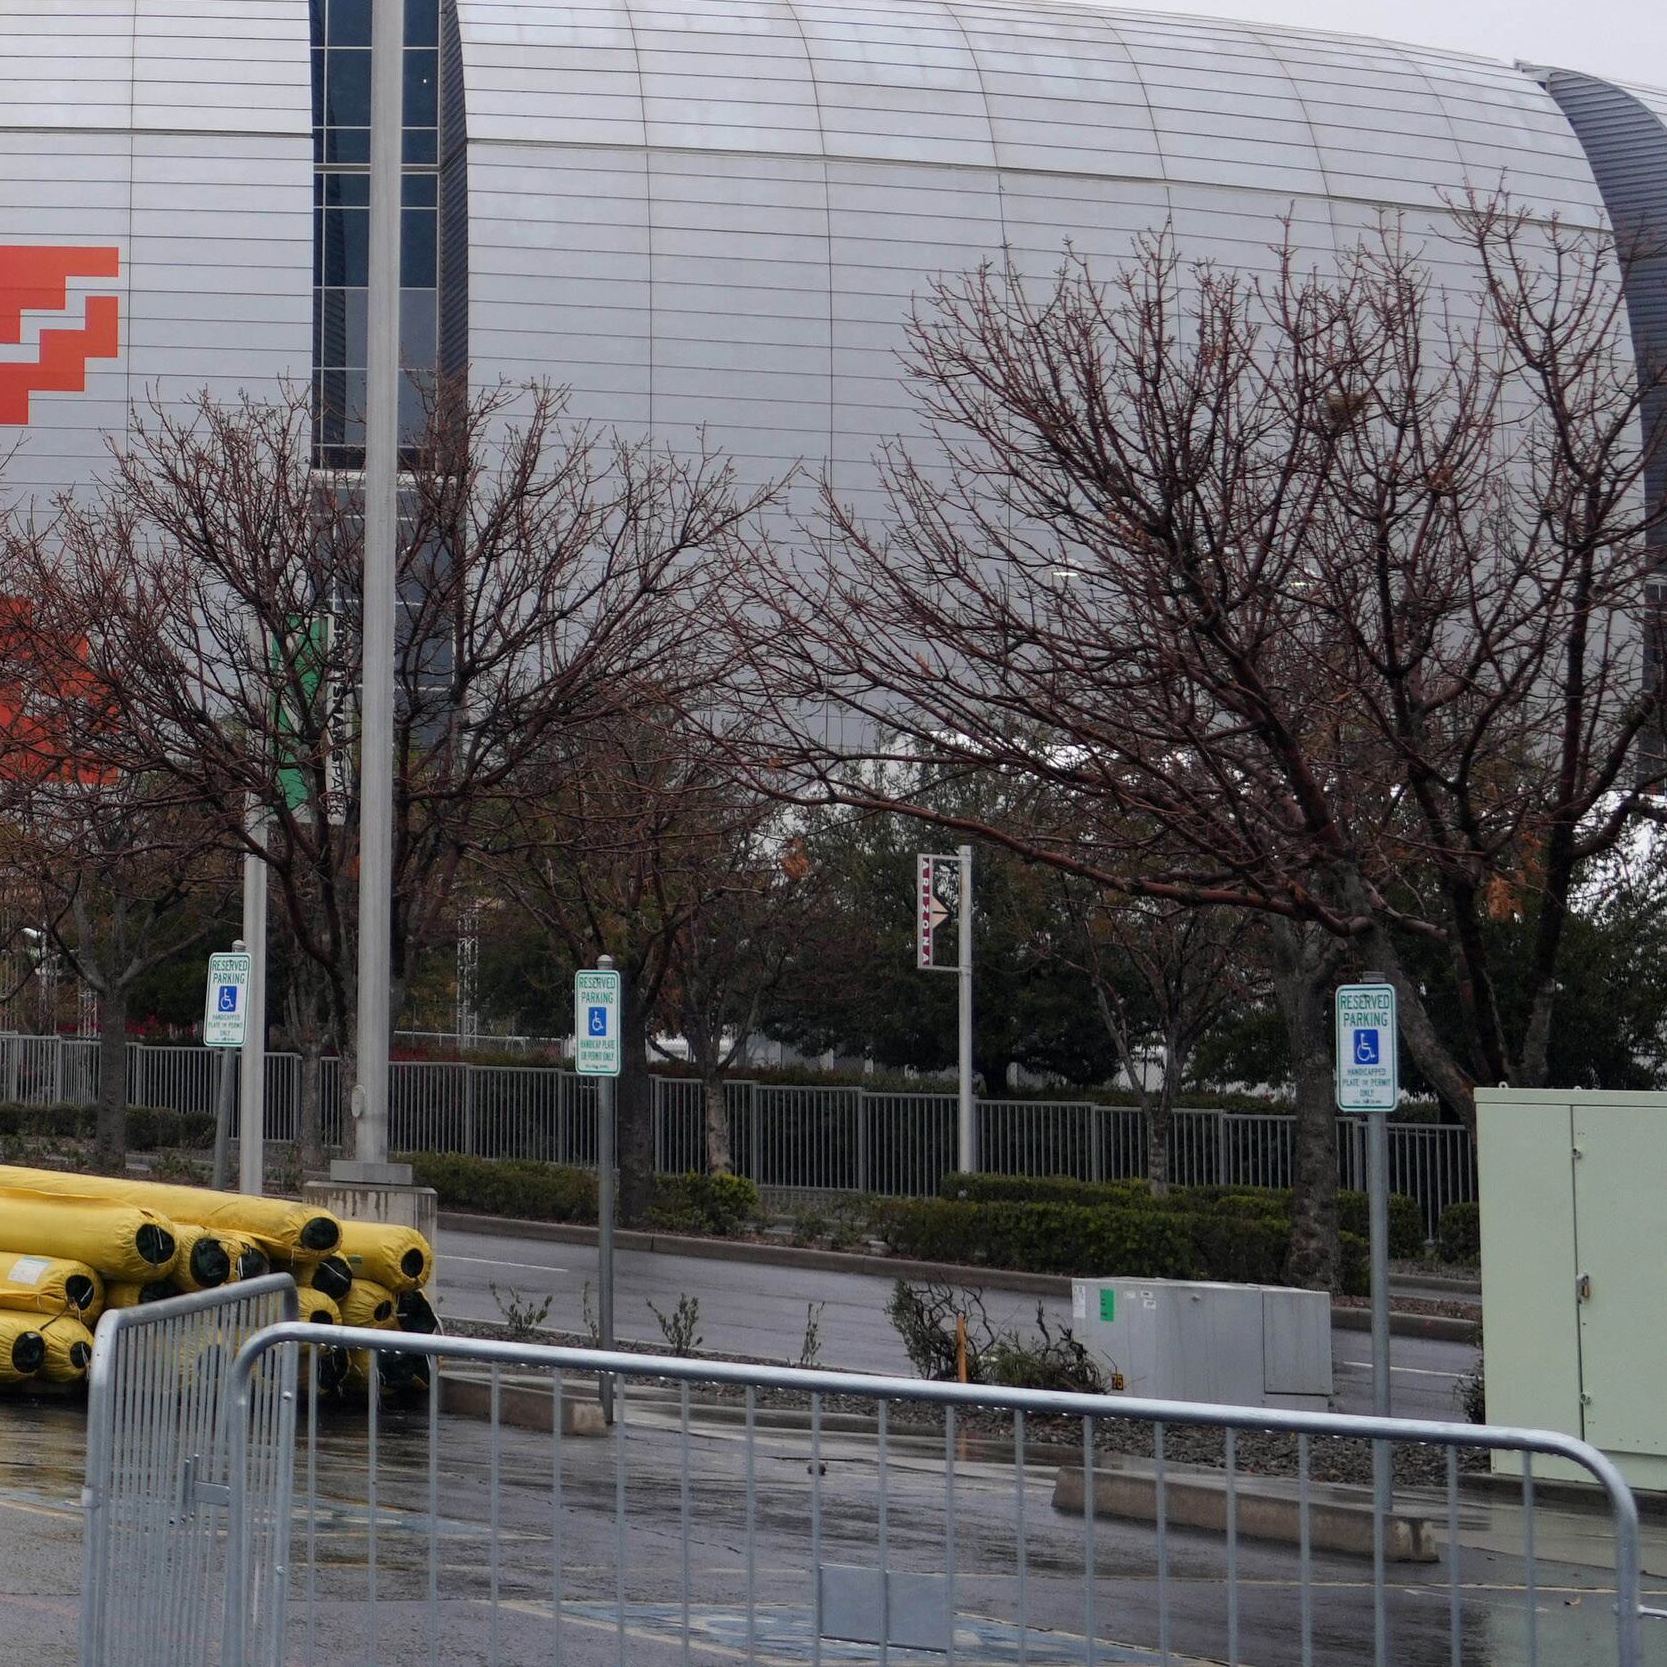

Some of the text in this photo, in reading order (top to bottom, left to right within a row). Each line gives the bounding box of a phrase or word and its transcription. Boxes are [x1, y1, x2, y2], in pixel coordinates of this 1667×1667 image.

[212, 960, 247, 971] RESERVED
[213, 973, 245, 984] PARKING
[579, 977, 615, 989] RESERVED
[581, 992, 613, 1004] PARKING
[1340, 995, 1389, 1009] RESERVED
[1343, 1013, 1388, 1027] PARKING
